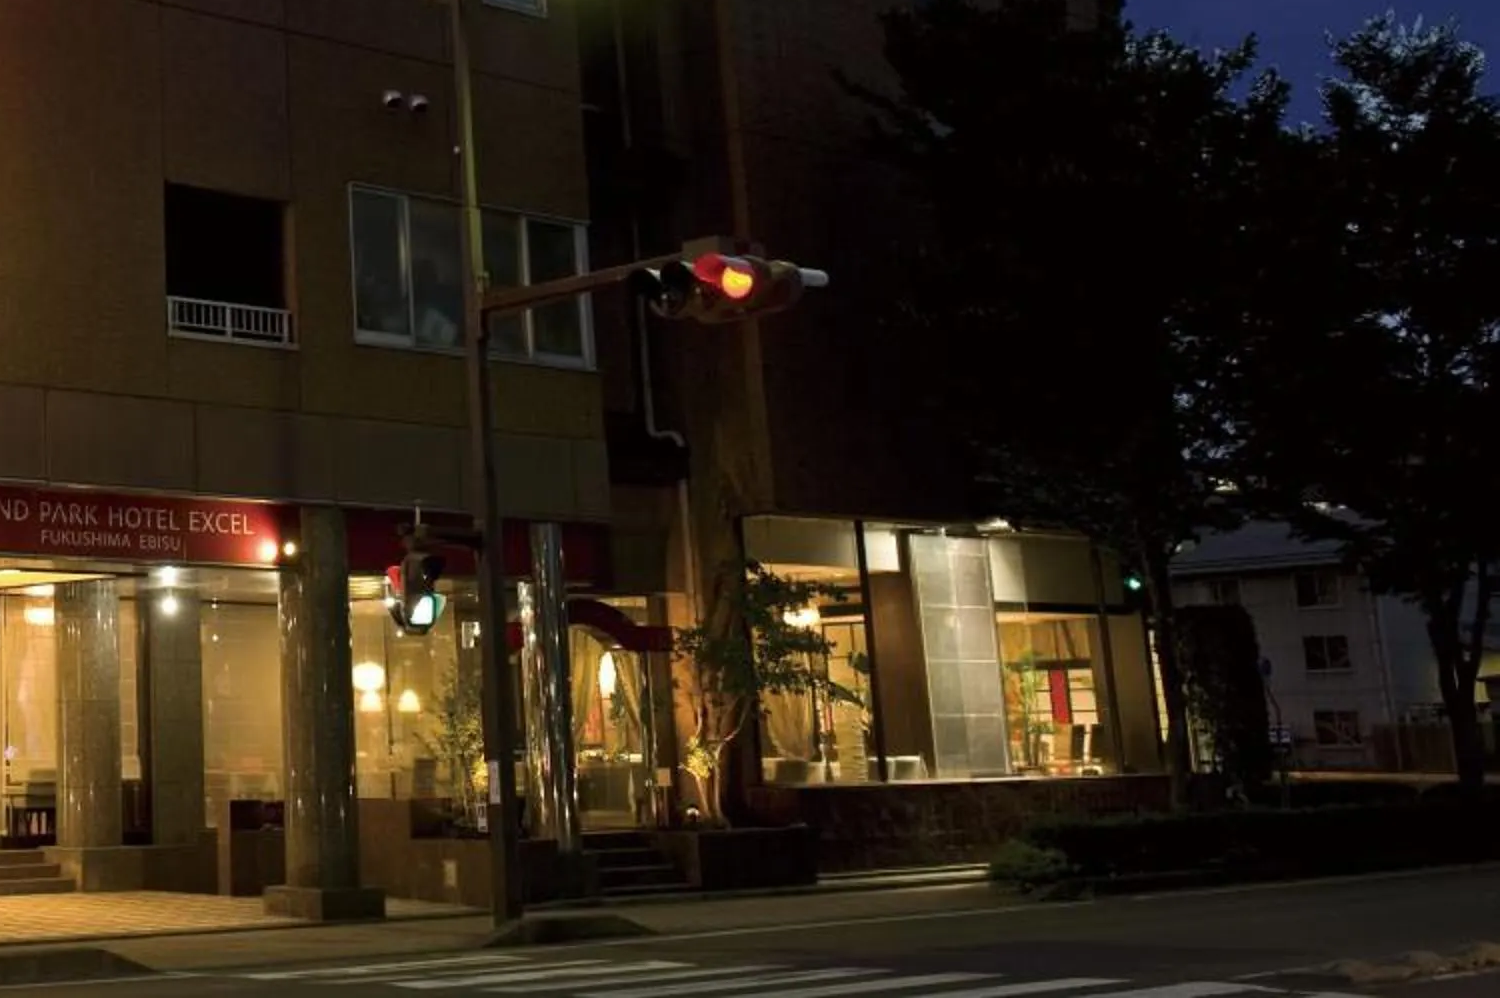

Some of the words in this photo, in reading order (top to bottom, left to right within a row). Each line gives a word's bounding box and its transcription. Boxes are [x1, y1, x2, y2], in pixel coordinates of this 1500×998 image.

[39, 501, 99, 526] PARK
[108, 505, 181, 531] HOTEL
[188, 511, 256, 535] EXCEL
[40, 529, 132, 548] FUKUSHIMA
[139, 534, 181, 551] EBISU
